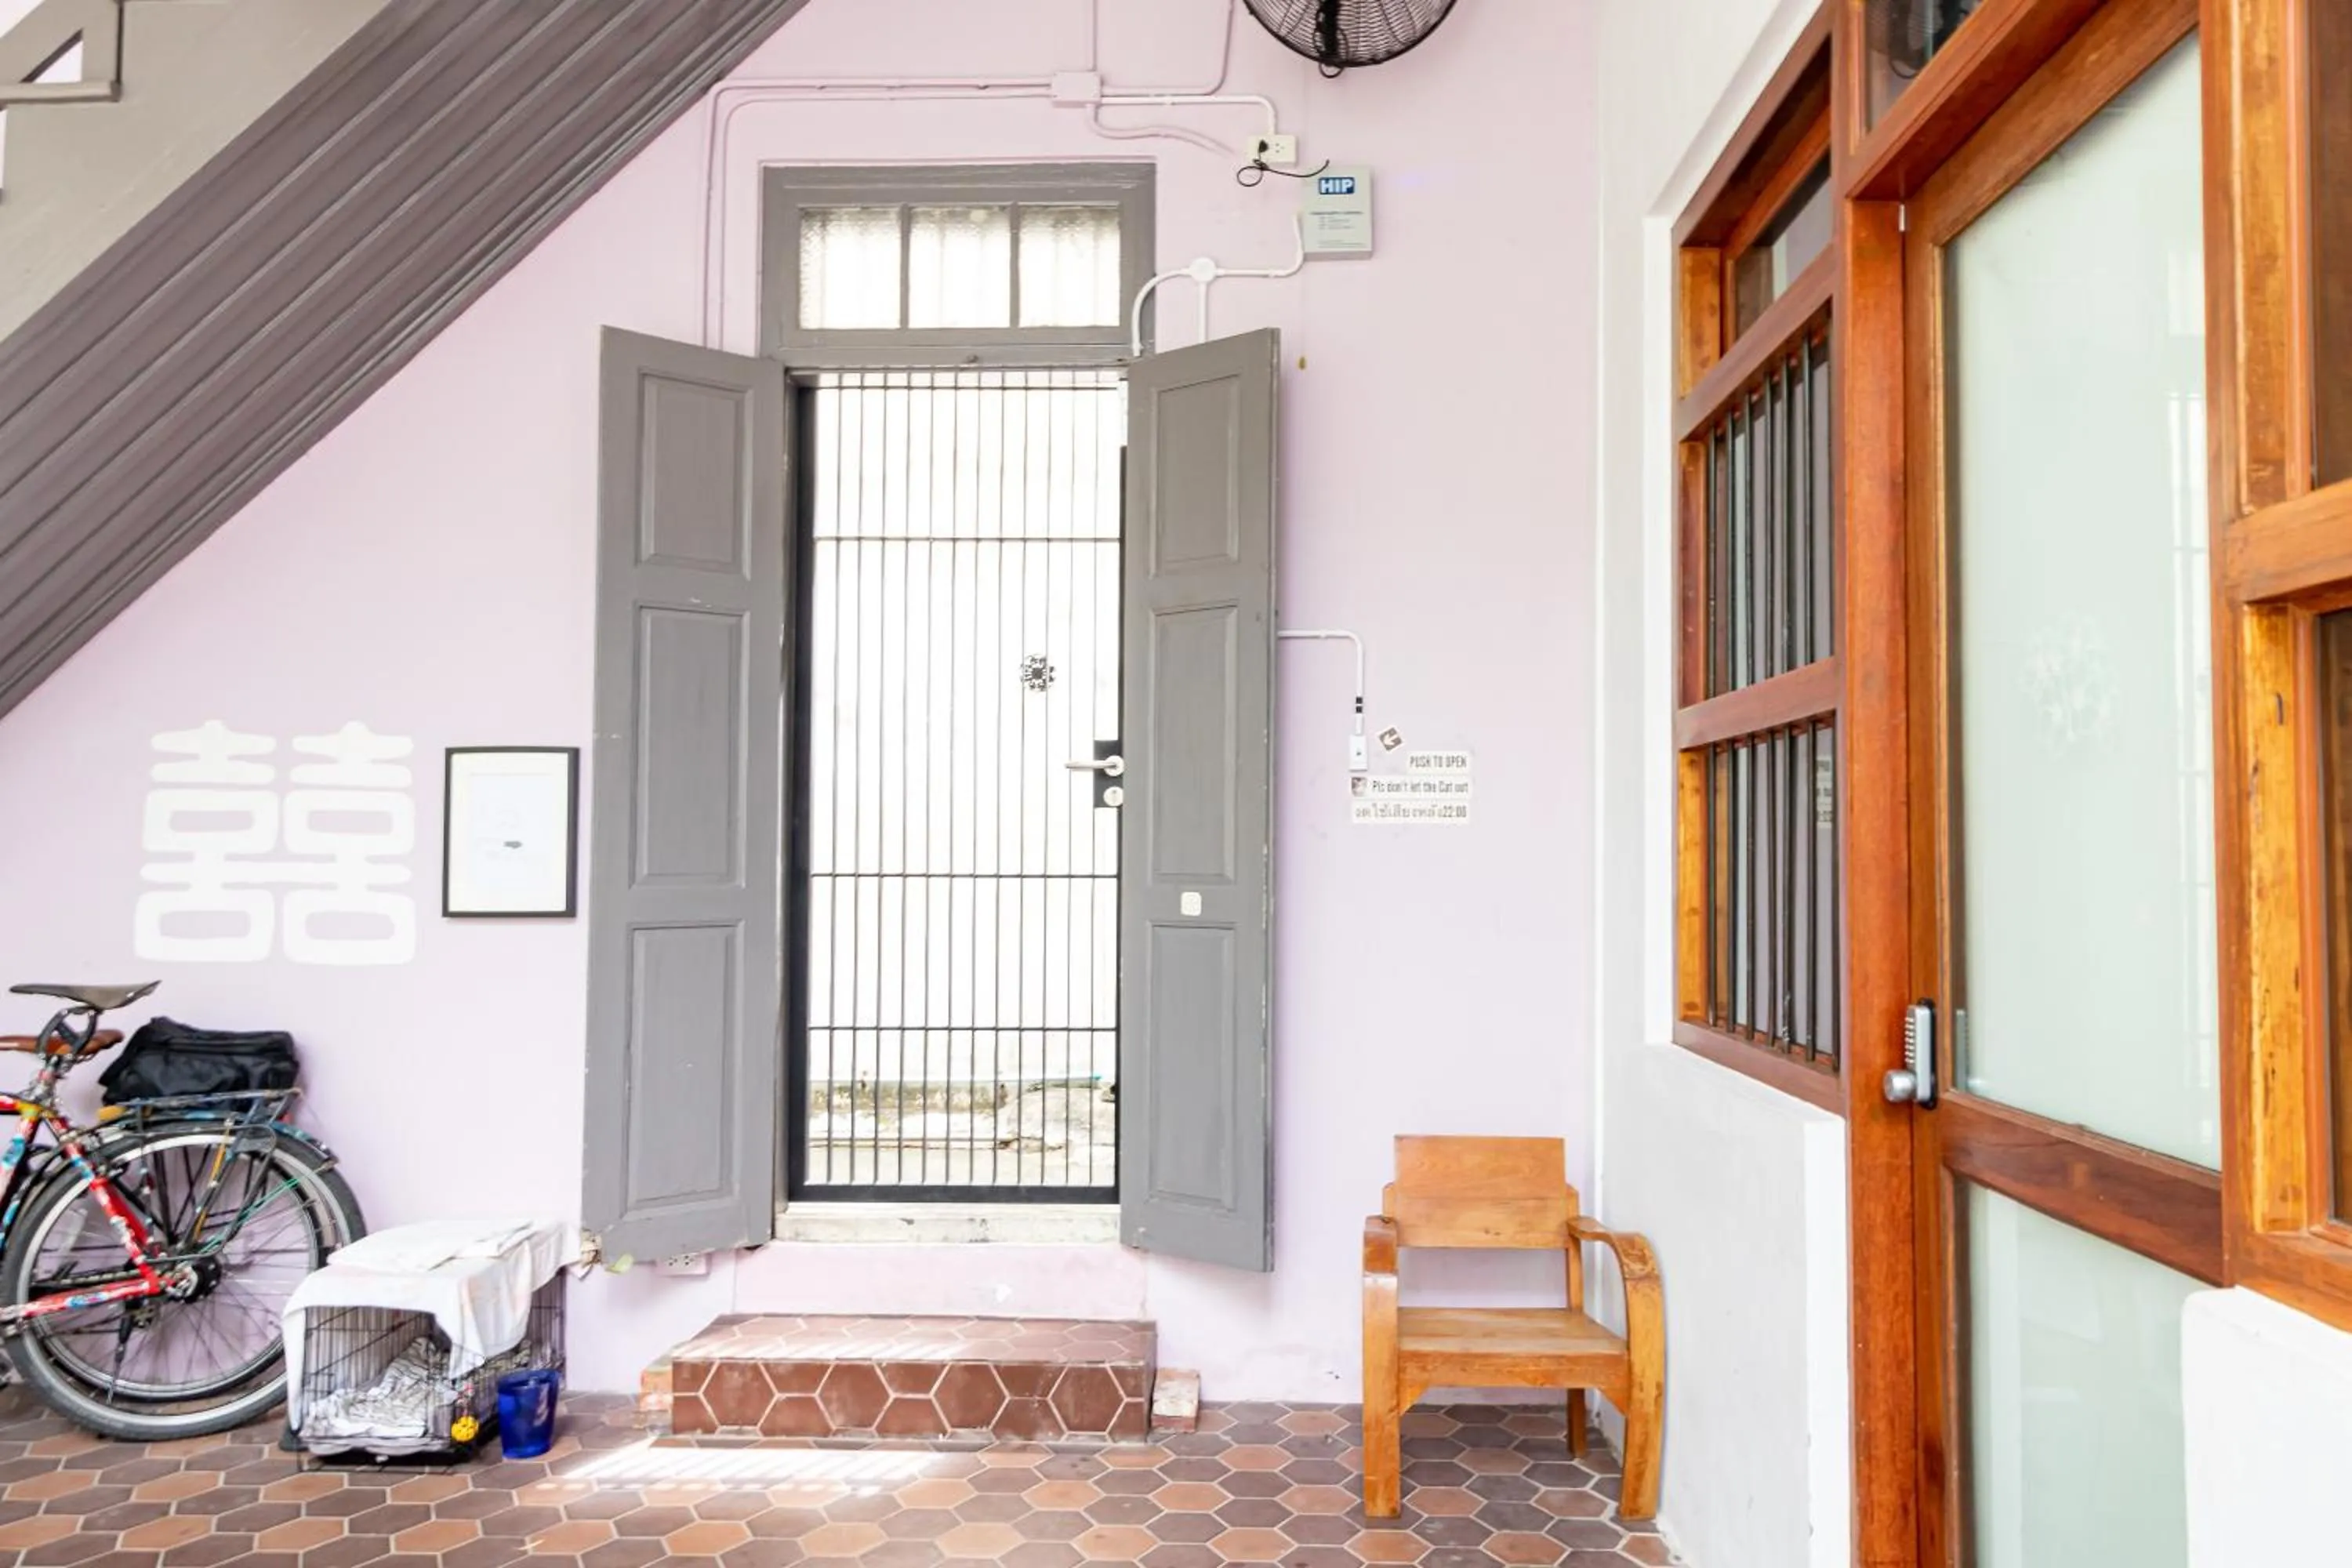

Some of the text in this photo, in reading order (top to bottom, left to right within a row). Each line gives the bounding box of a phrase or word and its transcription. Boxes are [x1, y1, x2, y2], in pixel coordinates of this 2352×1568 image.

[1320, 179, 1353, 194] HIP
[1410, 755, 1467, 768] PUSH TO OPEN
